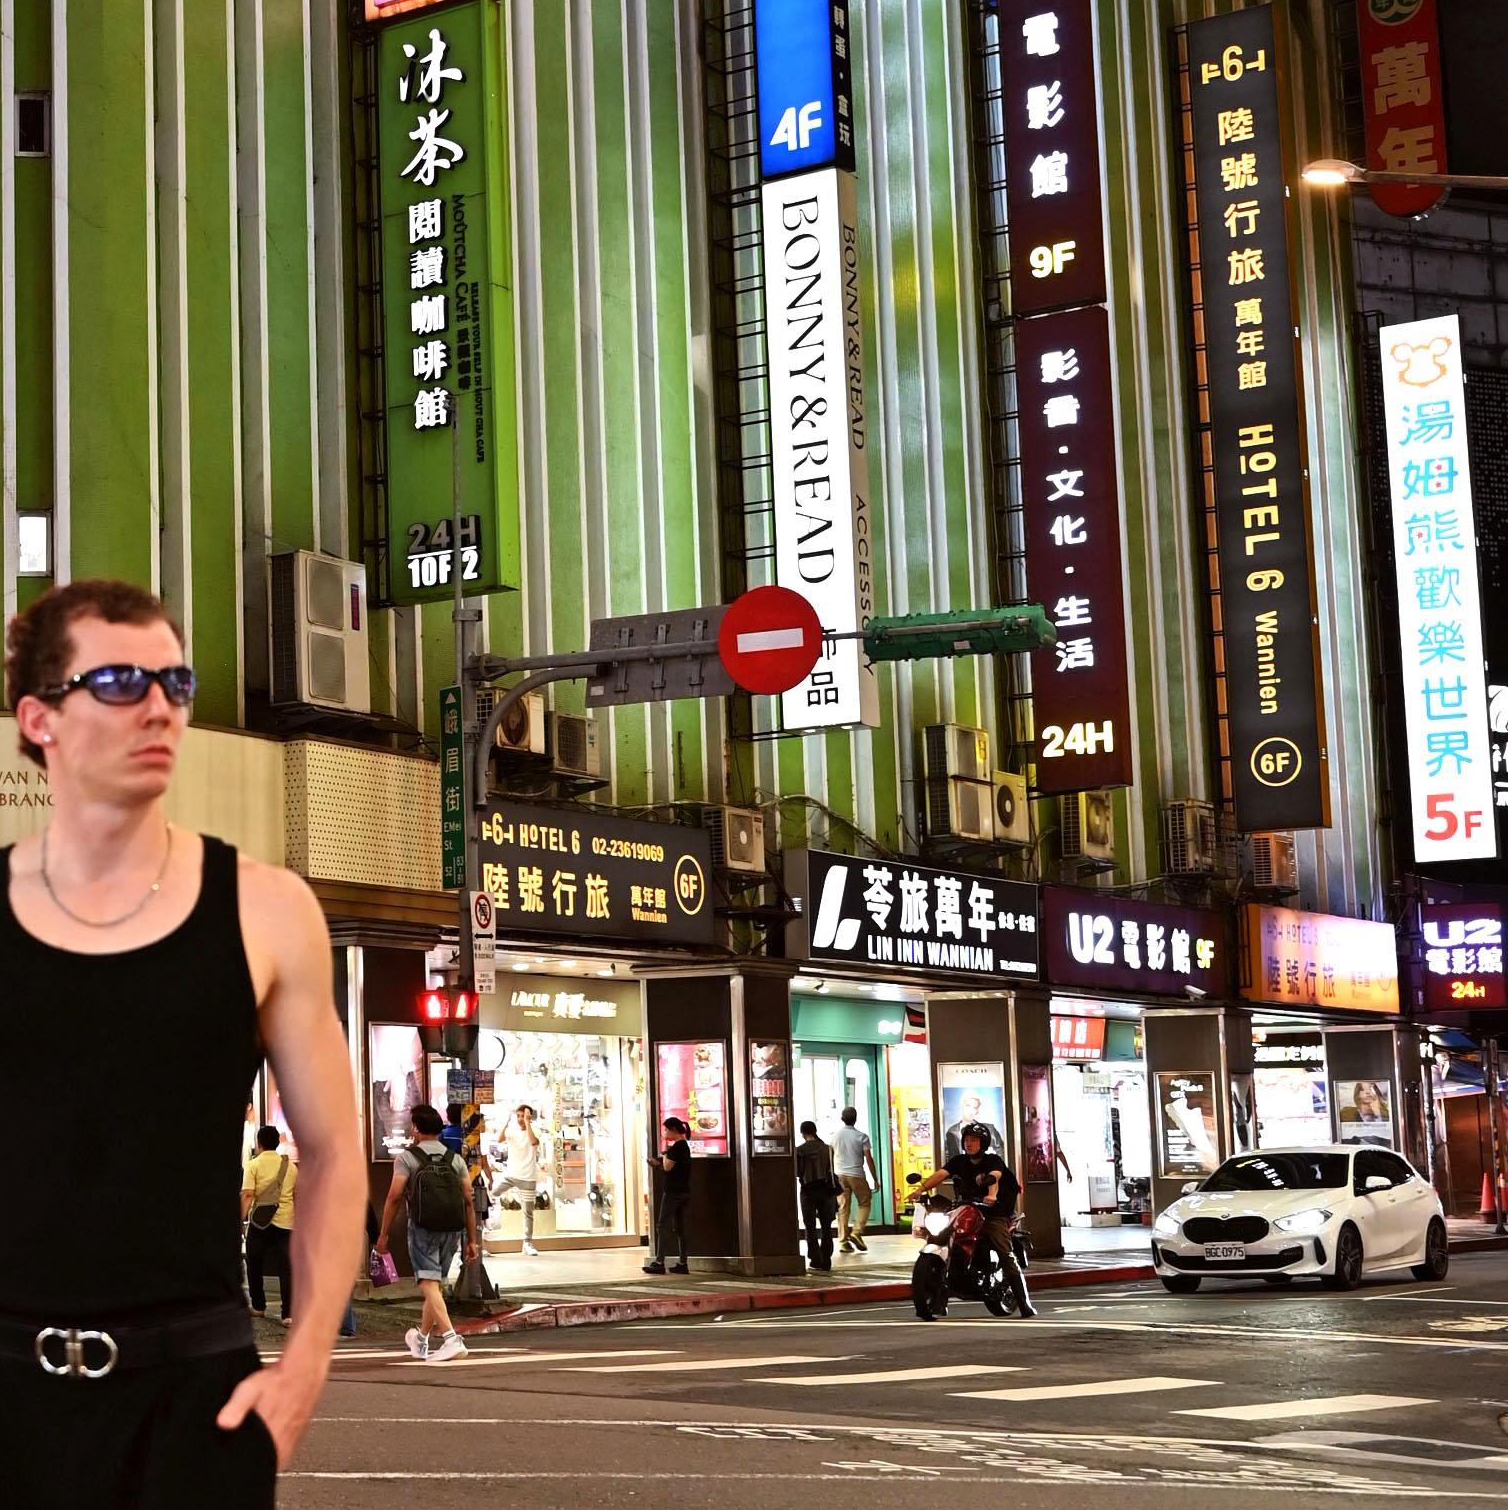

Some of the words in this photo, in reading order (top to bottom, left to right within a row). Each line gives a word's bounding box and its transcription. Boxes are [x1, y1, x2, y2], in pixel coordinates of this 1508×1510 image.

[769, 99, 823, 152] 4F
[1022, 11, 1069, 199] 電影館
[1371, 41, 1438, 189] 萬年
[1217, 106, 1265, 286] 陸號行旅
[1029, 240, 1077, 279] 9F
[407, 196, 448, 430] 閱讀咖啡館
[1233, 297, 1267, 391] 萬年館
[792, 439, 835, 584] READ
[1238, 424, 1280, 556] HOTEL
[408, 514, 476, 554] 24H
[855, 493, 874, 676] ACCESSOY
[1246, 570, 1284, 592] 6
[1398, 398, 1472, 778] 湯姆熊歡樂世界
[1255, 610, 1283, 715] Wannien
[444, 708, 460, 812] 峨眉街
[1041, 720, 1114, 759] 24H
[1260, 751, 1291, 776] 6F
[519, 823, 567, 853] HOTEL
[571, 829, 580, 855] 6
[591, 836, 664, 863] 02-23619069
[1422, 792, 1485, 843] 5F
[482, 862, 610, 919] 陸號行旅
[630, 884, 667, 909] 萬年館
[679, 872, 698, 899] 6F
[862, 864, 997, 943] 苓旅萬年
[867, 934, 893, 961] LIN
[897, 937, 924, 964] INN
[926, 941, 994, 972] WANNIAN
[1068, 912, 1115, 965] U2
[1423, 918, 1502, 948] U2
